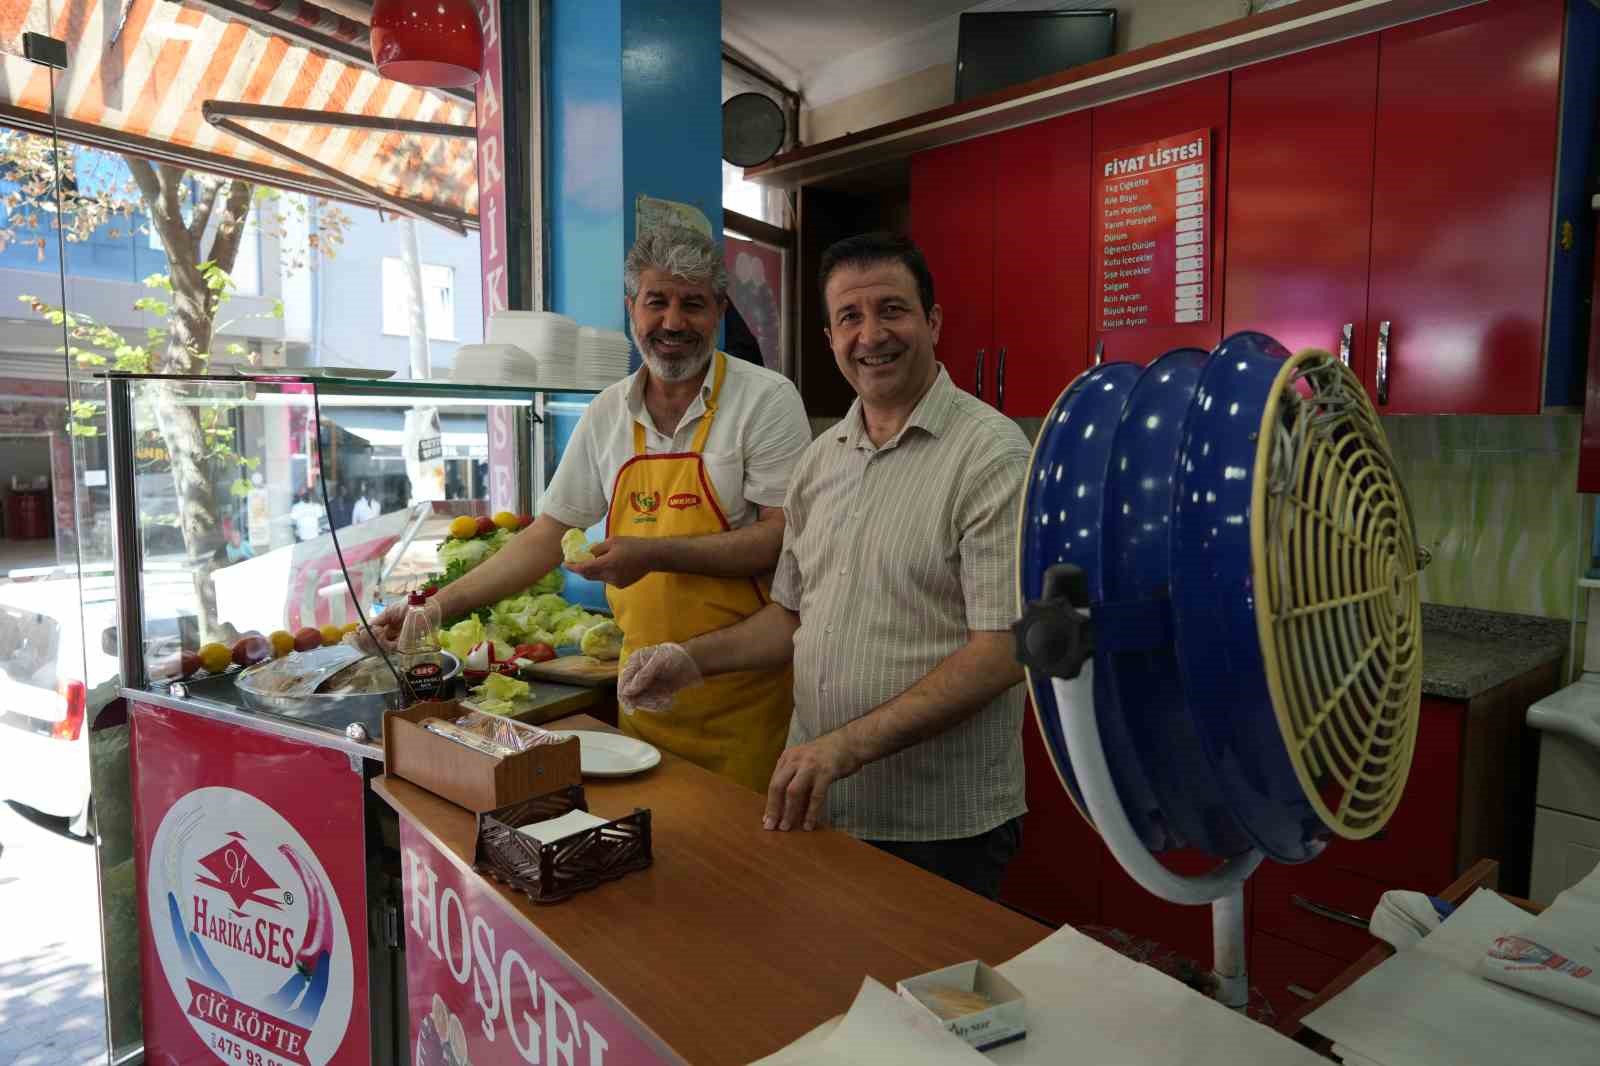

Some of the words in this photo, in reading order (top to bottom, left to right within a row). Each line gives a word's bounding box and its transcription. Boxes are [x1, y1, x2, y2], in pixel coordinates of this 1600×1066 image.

[1104, 155, 1146, 177] FİYAT
[1150, 138, 1203, 168] LİSTESİ
[1104, 209, 1120, 217] Tam
[1119, 293, 1141, 304] Ayran
[1127, 304, 1148, 315] Ayran
[1126, 317, 1147, 328] Ayran
[196, 992, 229, 1024] ÇİĞ
[233, 1008, 302, 1057] KÖFTE
[218, 1036, 242, 1060] 475
[246, 1049, 262, 1066] 93
